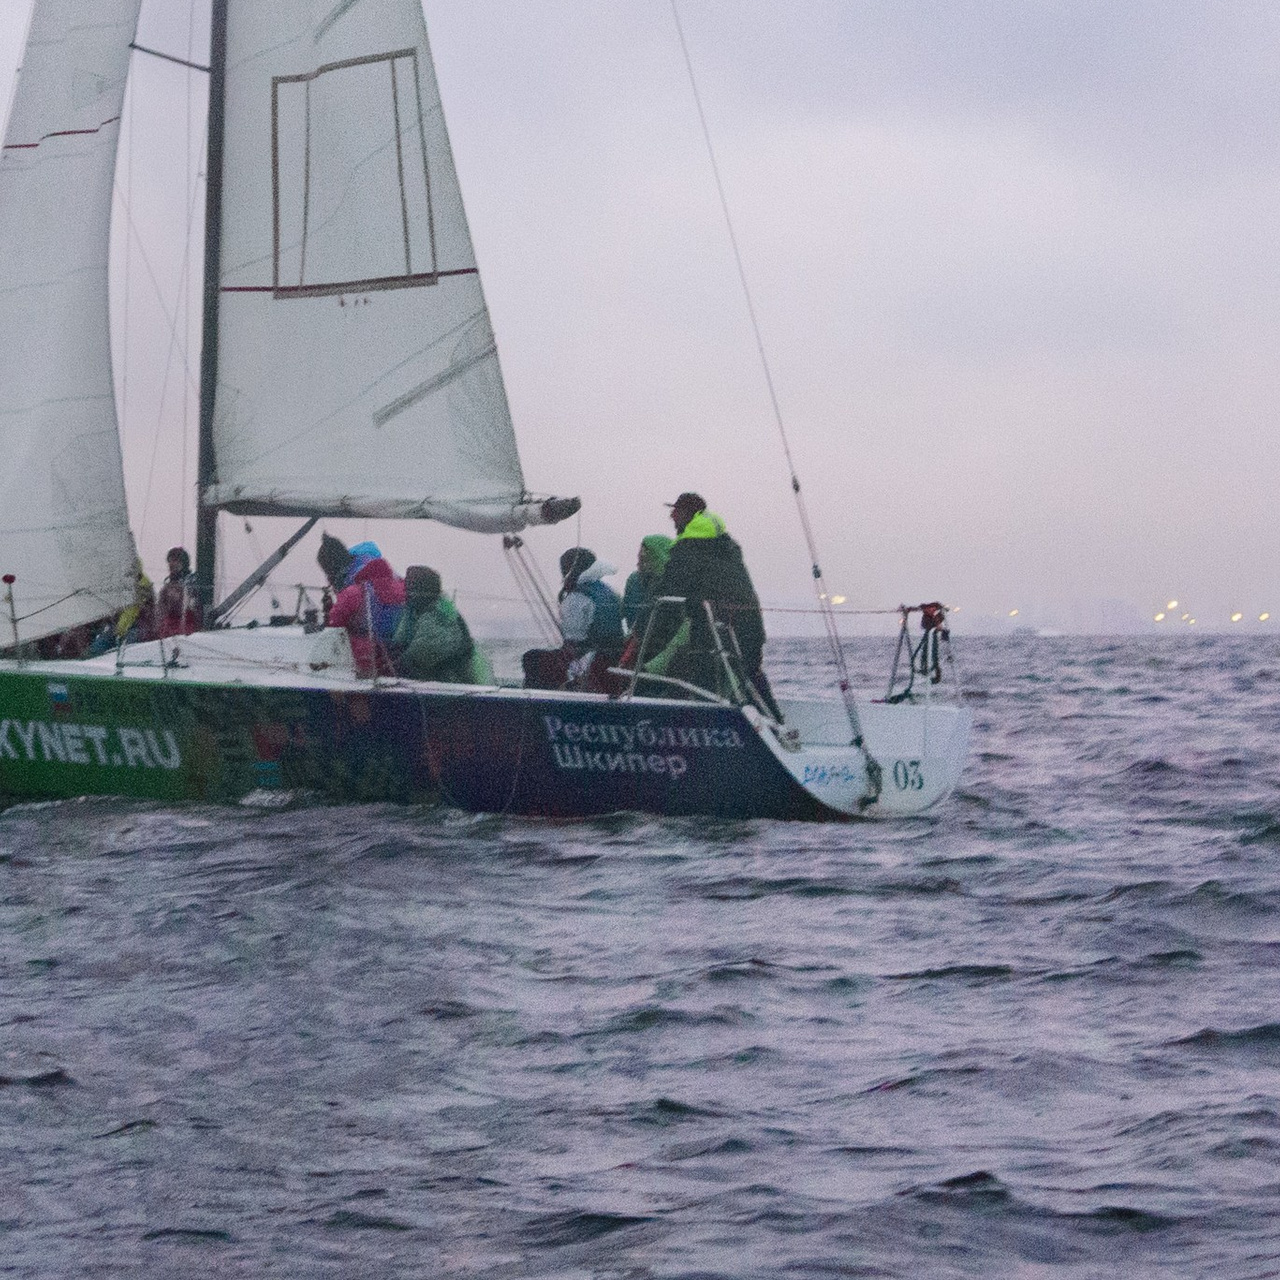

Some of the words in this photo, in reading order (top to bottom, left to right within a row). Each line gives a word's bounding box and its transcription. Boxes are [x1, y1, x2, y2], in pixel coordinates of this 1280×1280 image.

[544, 715, 745, 752] Республика
[552, 743, 688, 780] Шкипер
[893, 760, 924, 791] 03
